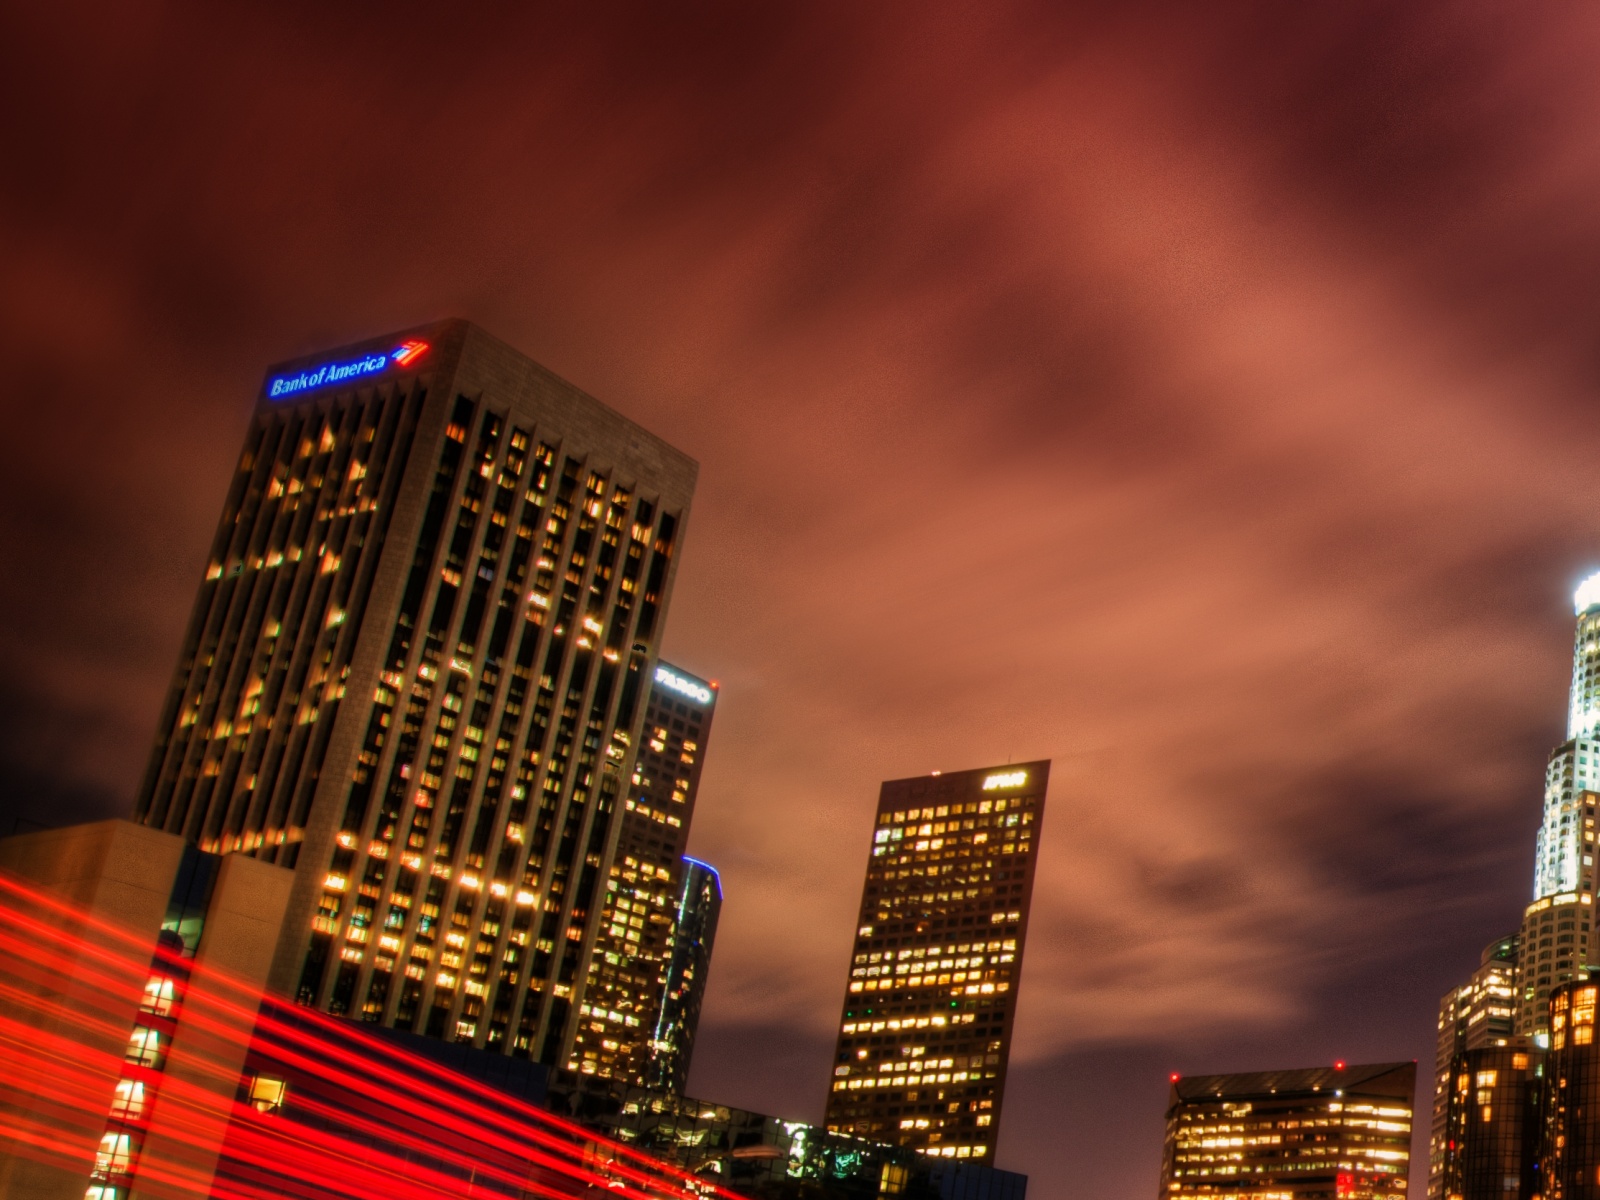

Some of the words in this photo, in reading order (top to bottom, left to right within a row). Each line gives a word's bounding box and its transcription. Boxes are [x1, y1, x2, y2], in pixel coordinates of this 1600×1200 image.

[270, 376, 307, 397] Bank
[309, 368, 326, 386] of
[326, 356, 386, 381] America
